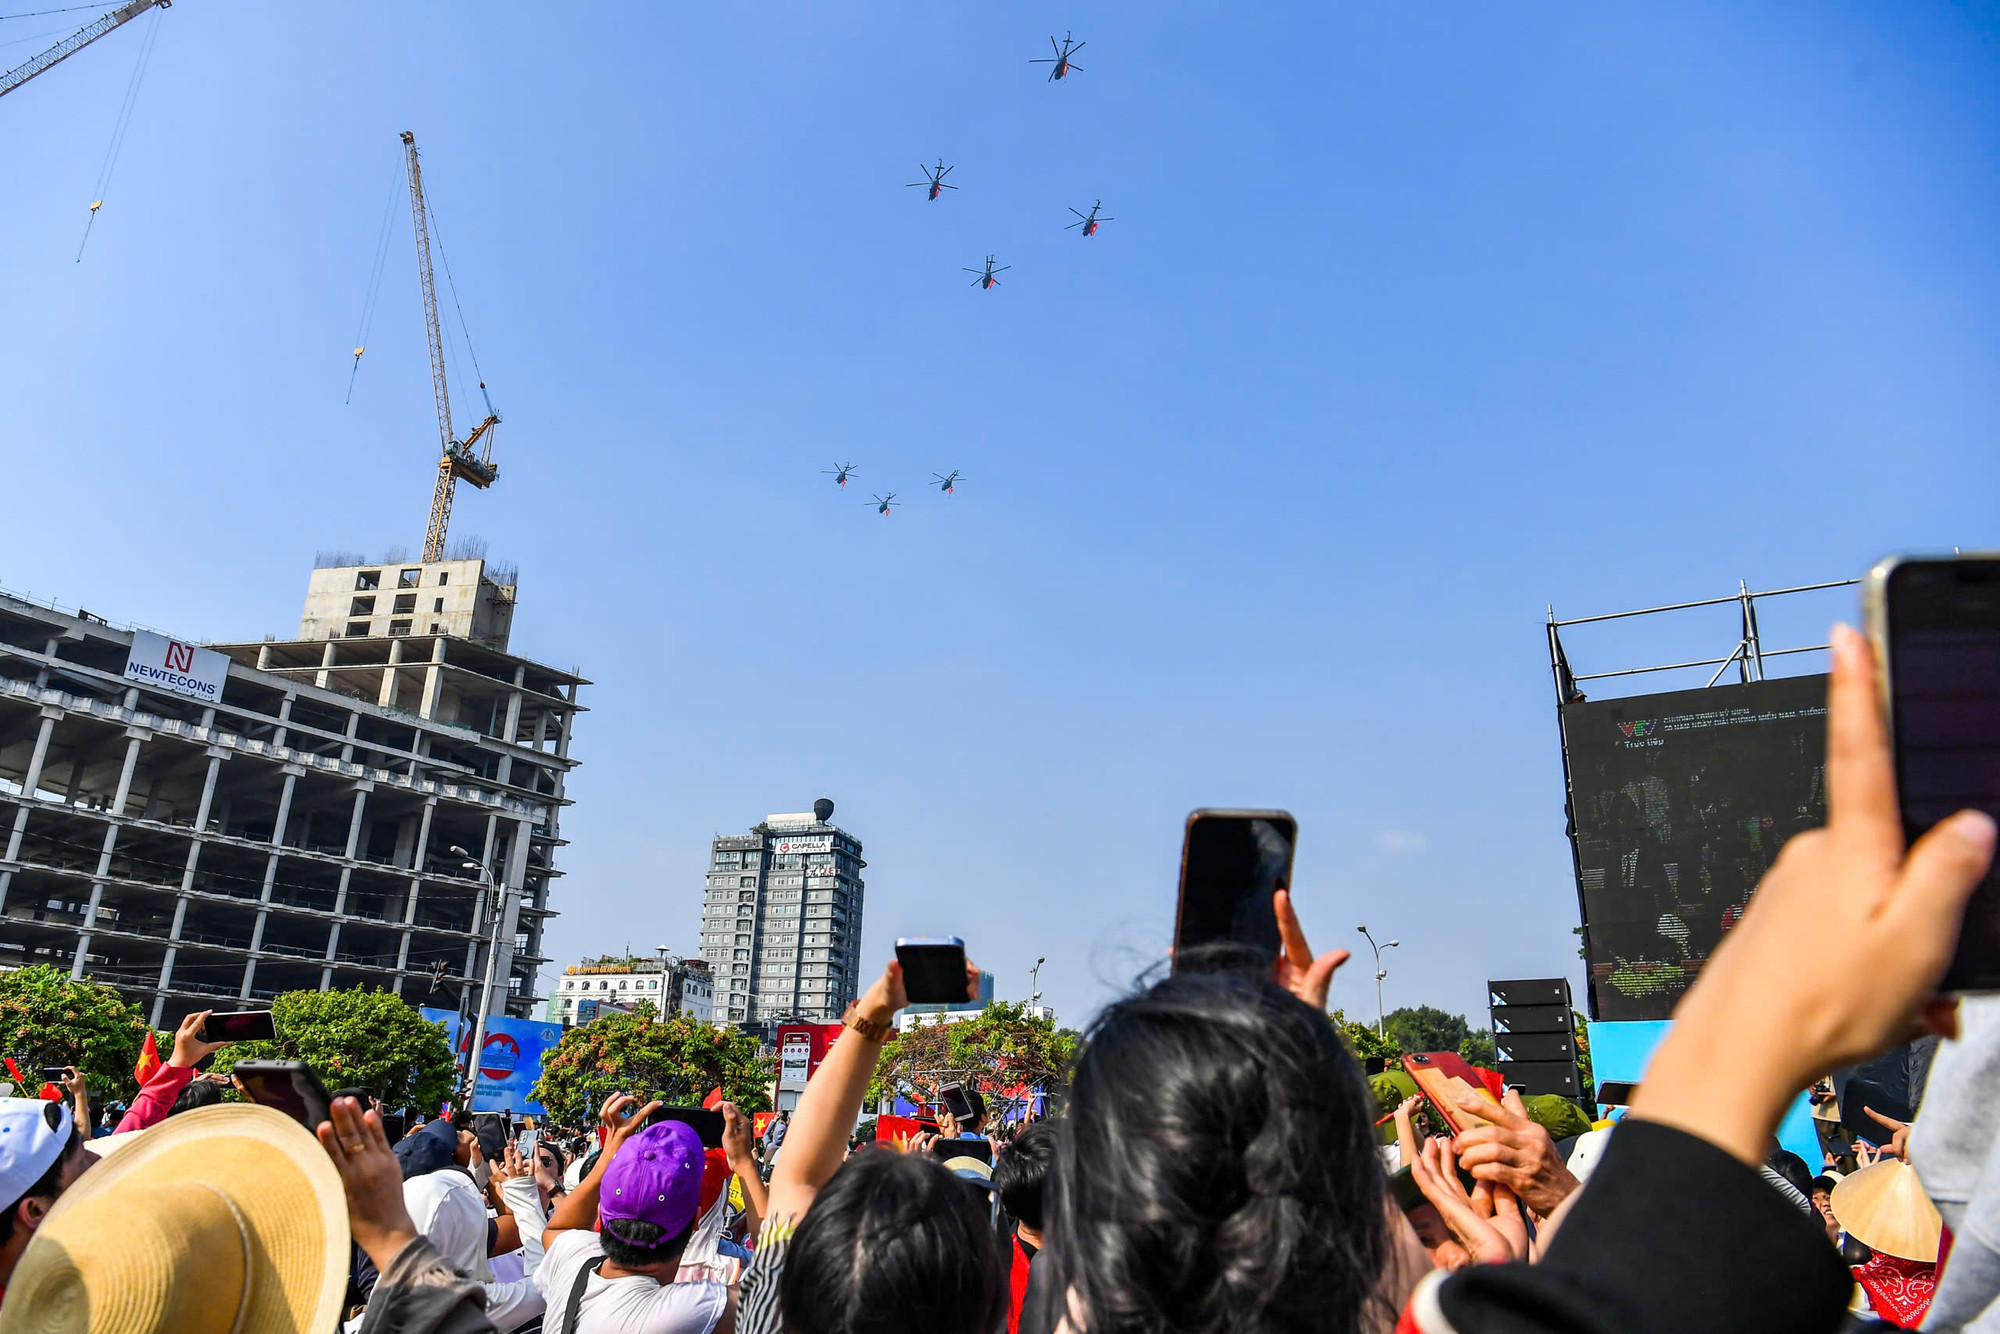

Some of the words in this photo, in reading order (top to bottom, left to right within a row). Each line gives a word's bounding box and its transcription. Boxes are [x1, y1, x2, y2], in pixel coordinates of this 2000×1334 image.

[164, 640, 195, 674] N
[128, 661, 216, 695] NEWTECONS
[1617, 718, 1658, 738] VTV
[1758, 711, 1777, 721] MIỀN
